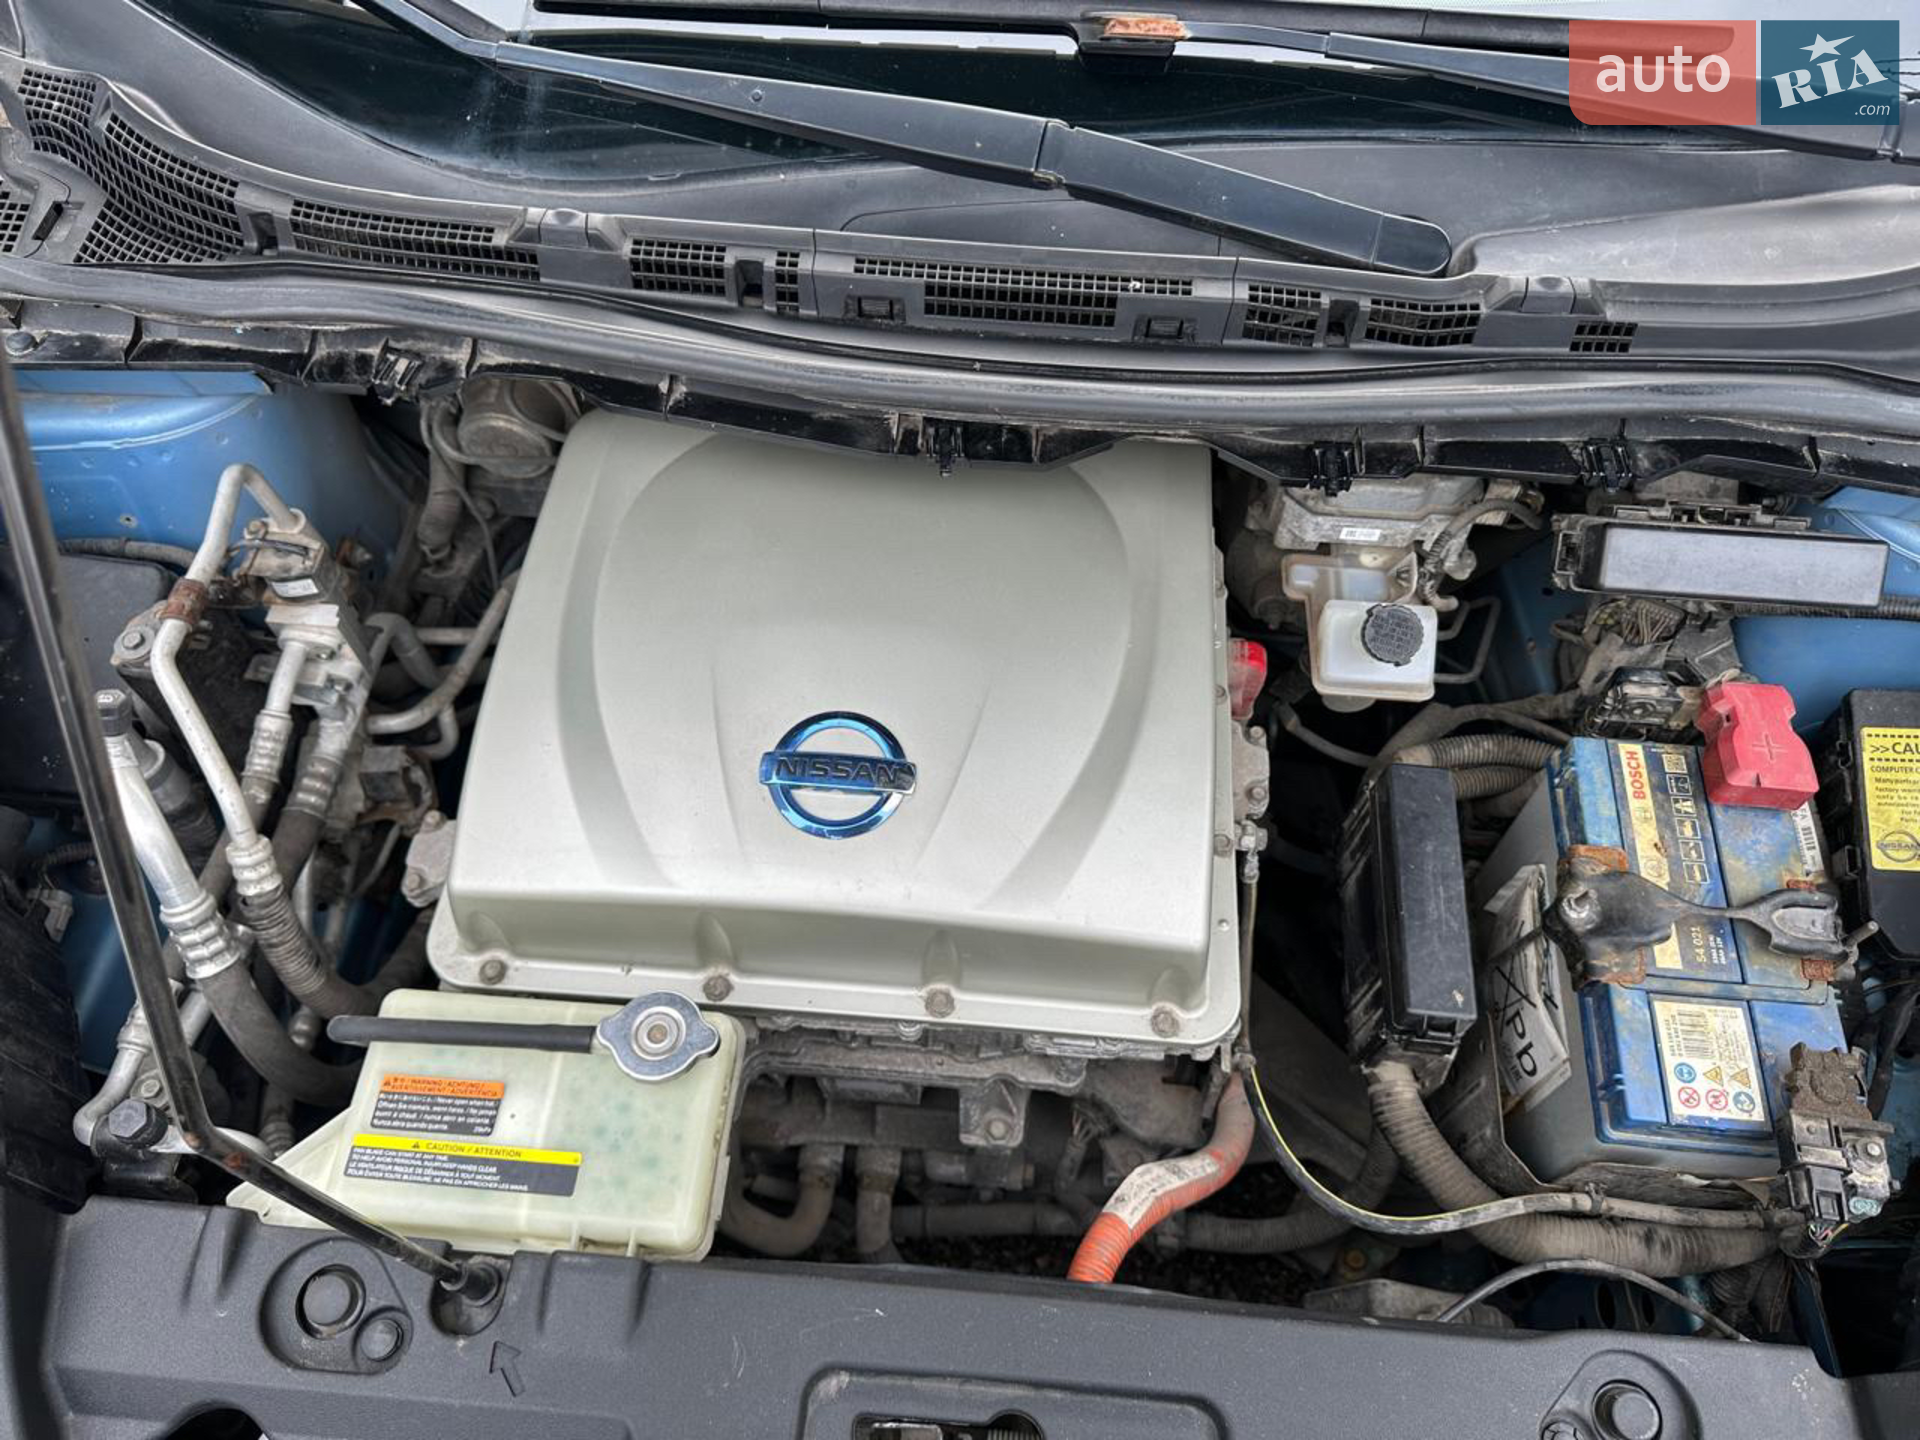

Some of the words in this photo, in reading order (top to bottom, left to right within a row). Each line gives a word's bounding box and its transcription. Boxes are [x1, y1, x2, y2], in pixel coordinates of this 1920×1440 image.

[774, 757, 898, 784] NISSAN
[1625, 751, 1646, 800] BOSCH
[426, 1142, 464, 1152] CAUTION
[474, 1146, 521, 1157] ATTENTION
